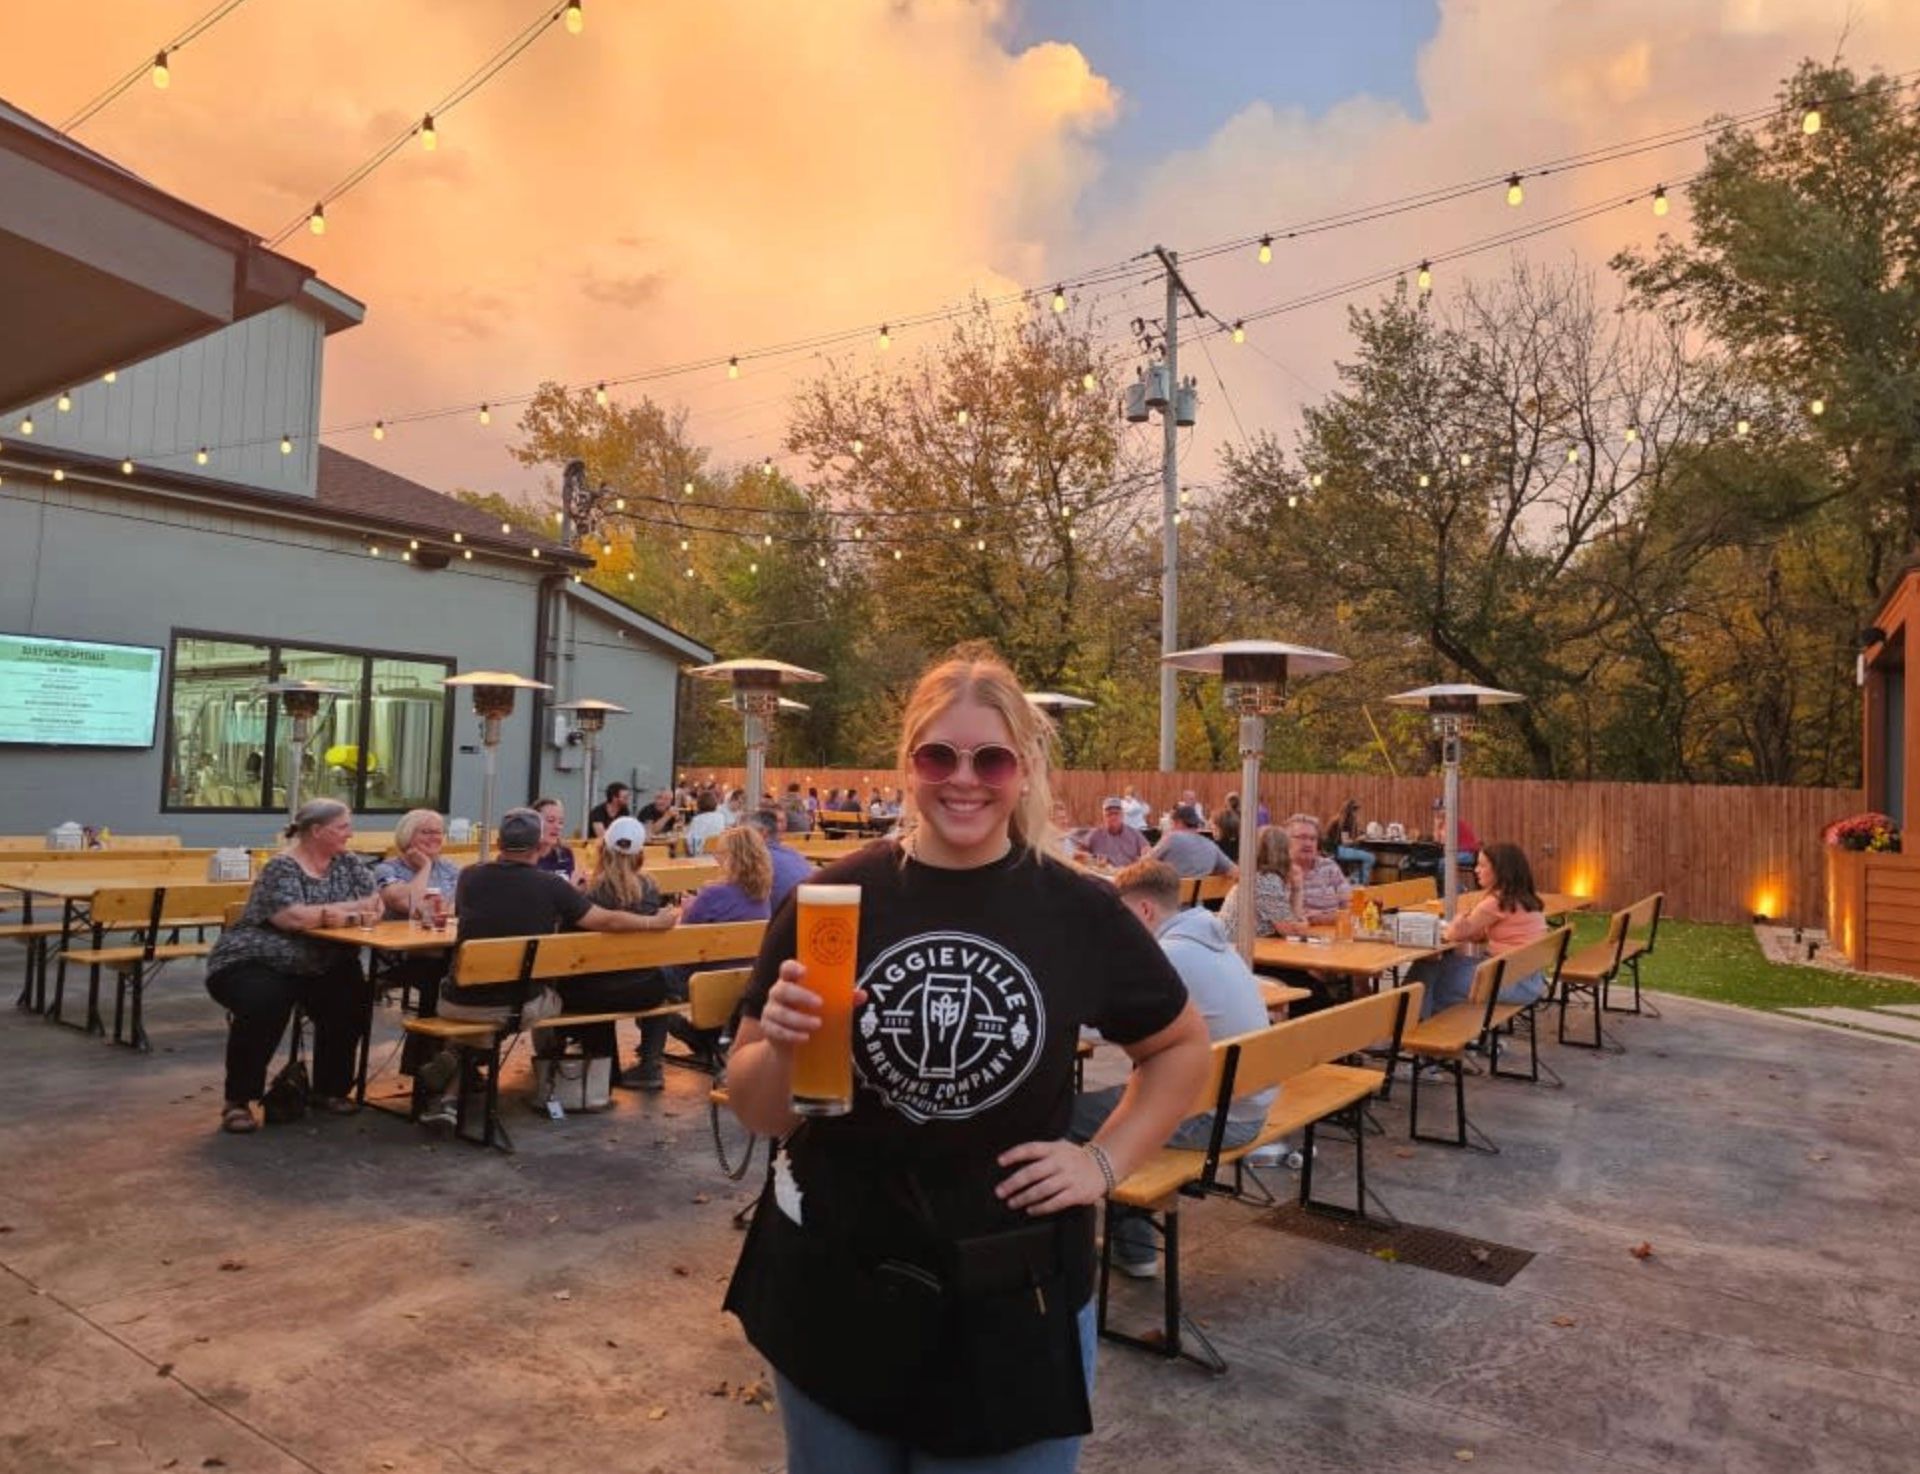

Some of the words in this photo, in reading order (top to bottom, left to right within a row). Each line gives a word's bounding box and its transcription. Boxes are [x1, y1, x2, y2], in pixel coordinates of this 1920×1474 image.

[871, 947, 1029, 1011] AGGIEVILLE
[866, 1041, 930, 1096] BREWING
[934, 1048, 1015, 1100] COMPANY
